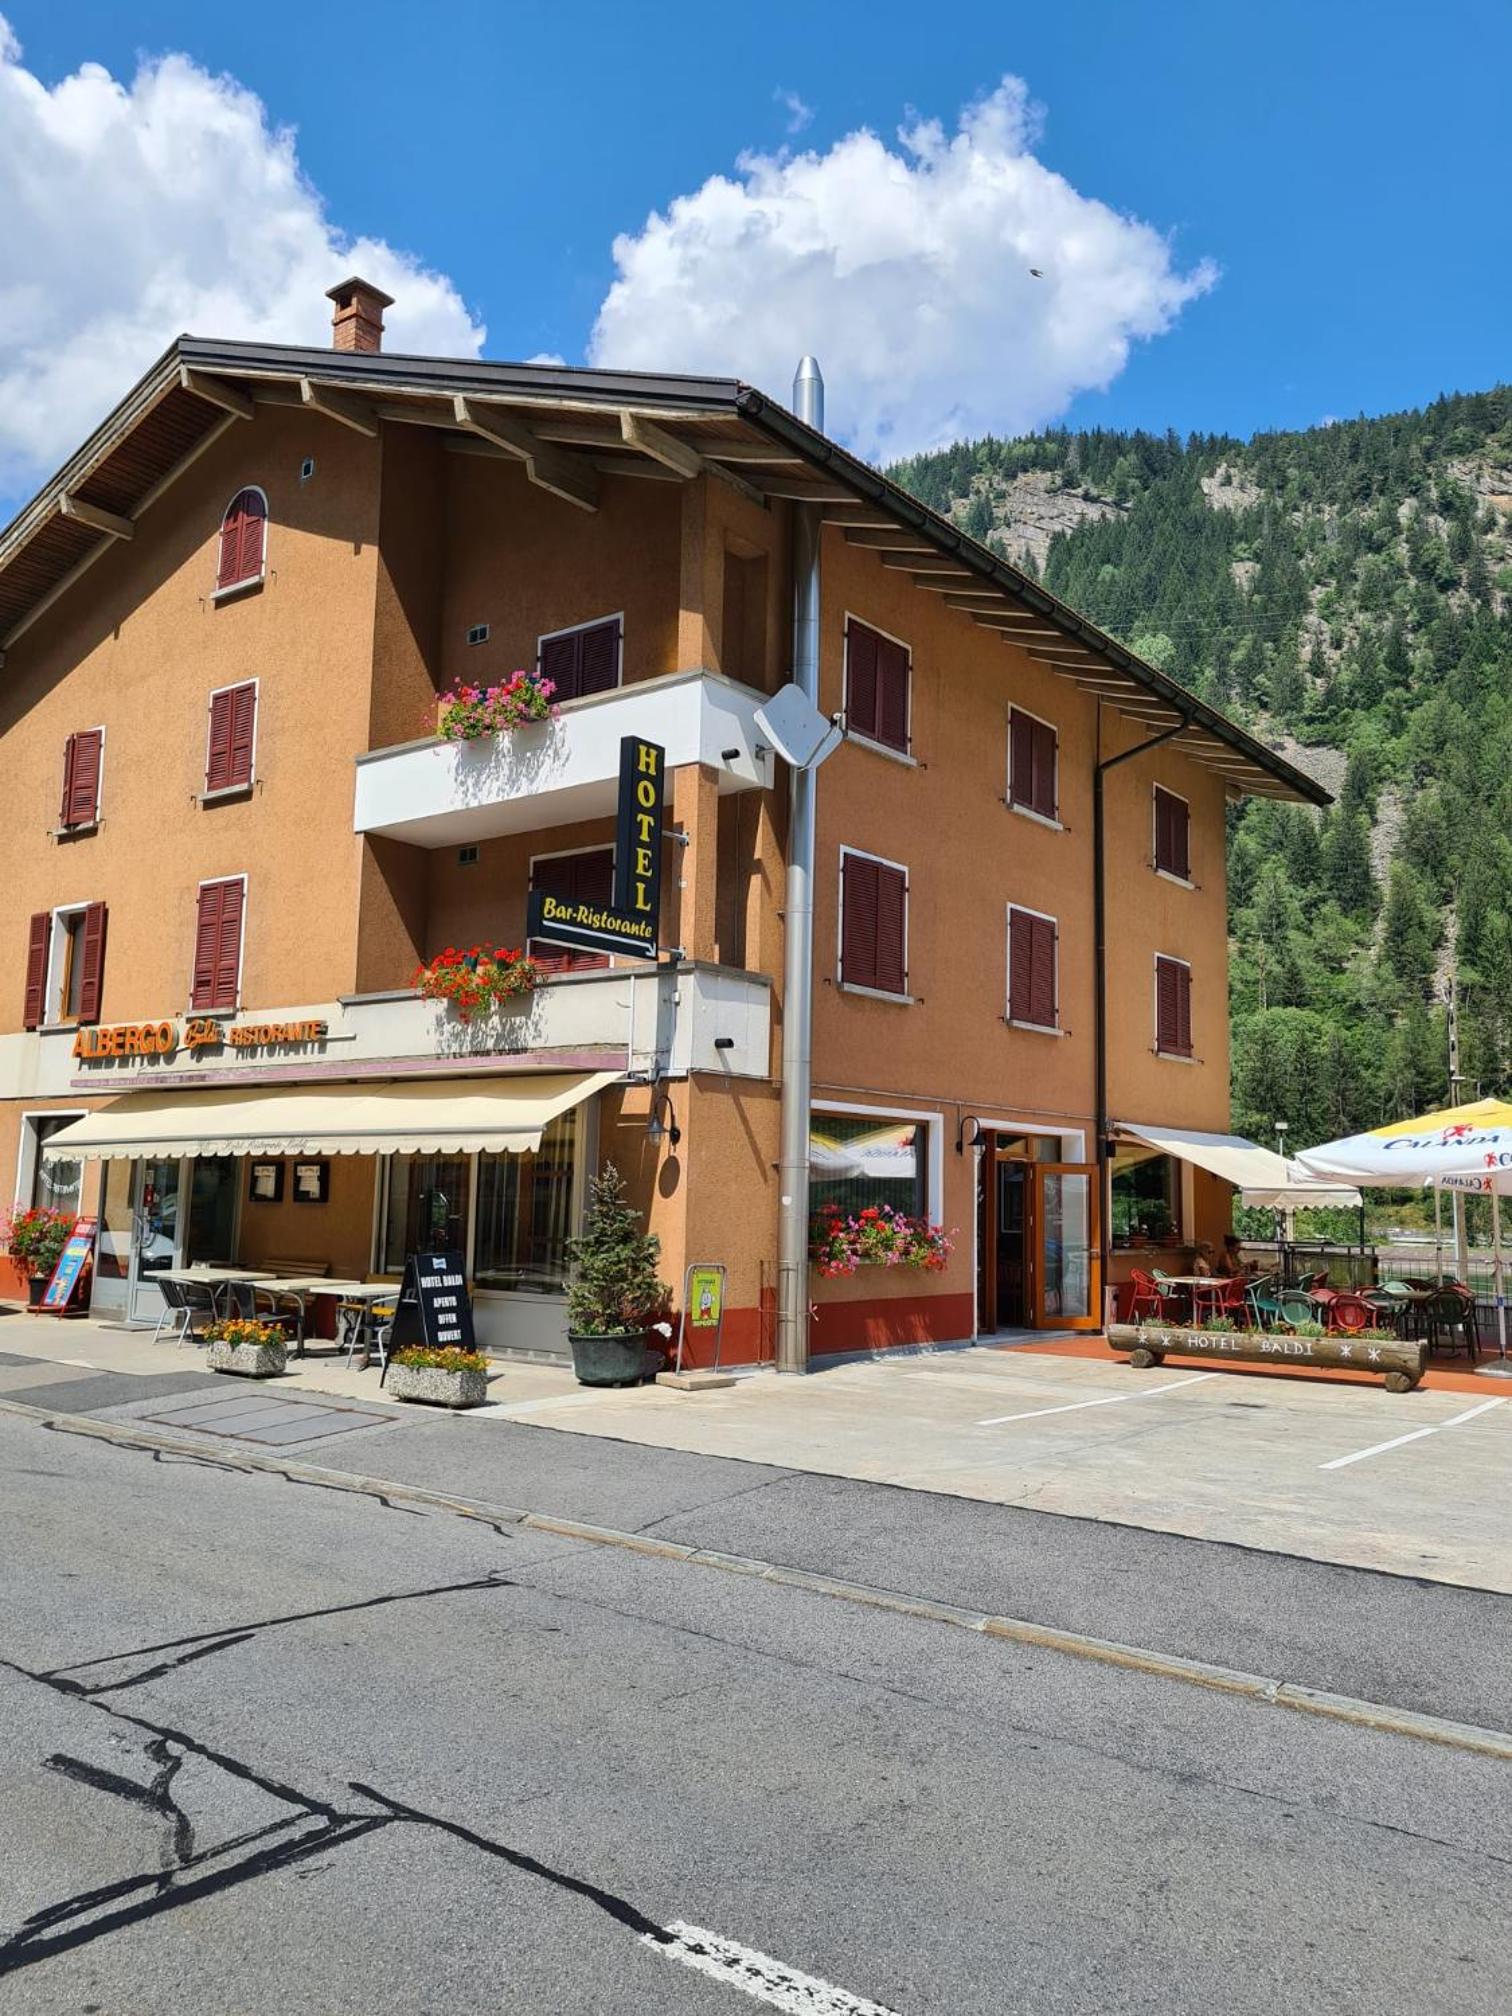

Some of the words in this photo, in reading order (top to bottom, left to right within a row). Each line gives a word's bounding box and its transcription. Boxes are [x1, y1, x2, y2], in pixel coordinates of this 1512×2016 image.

[636, 745, 657, 911] HOTEL
[543, 897, 653, 938] Bar-Ristorante
[73, 1022, 173, 1058] ALBERGO
[229, 1021, 321, 1045] RISTORANTE
[421, 1275, 442, 1288] HOTEL
[1188, 1336, 1240, 1350] HOTEL
[1261, 1341, 1313, 1355] BALDI
